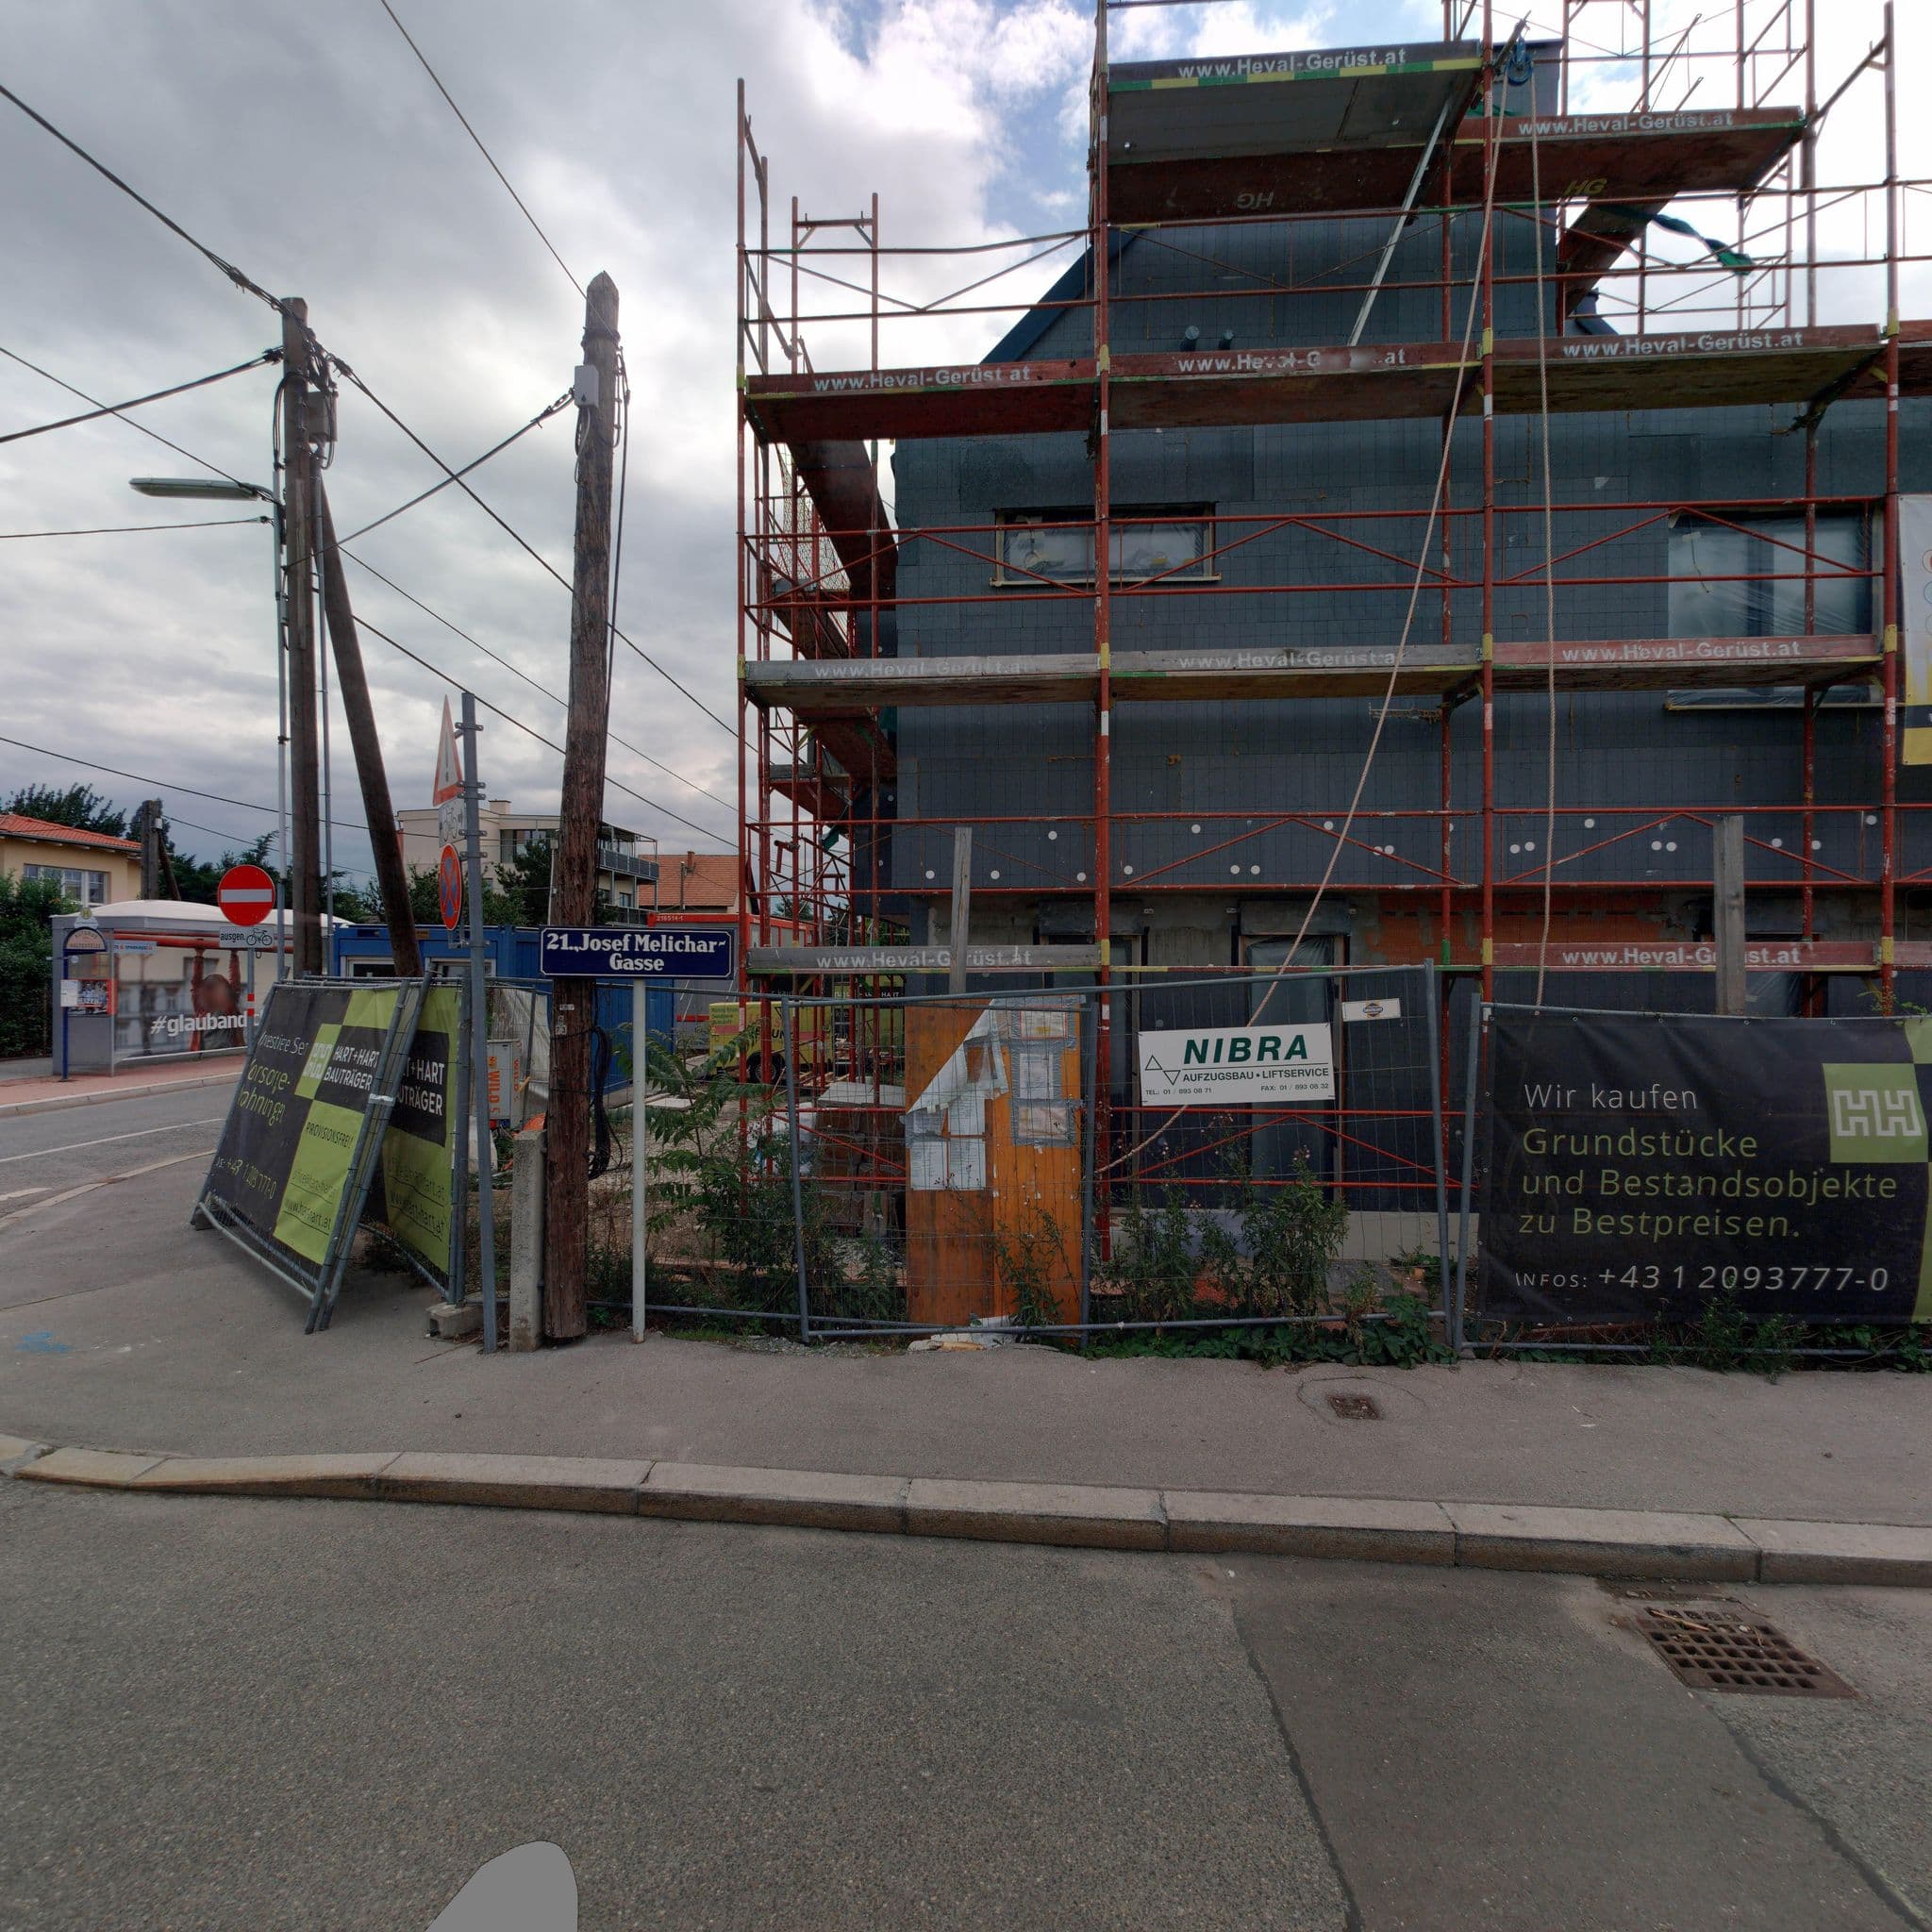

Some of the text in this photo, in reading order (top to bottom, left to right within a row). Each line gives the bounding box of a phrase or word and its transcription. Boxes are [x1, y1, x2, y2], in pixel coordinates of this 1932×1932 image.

[1178, 47, 1406, 78] www.Heval-Gerüst.at
[1518, 110, 1734, 136] www.Heval-Gerüst.at
[1563, 333, 1804, 358] www.Heval-Gerüst.at
[1177, 348, 1406, 372] www.Heval-G.at
[814, 365, 1030, 391] www.Heval-Gerüst.at
[1561, 640, 1801, 662] www.Heval-Gerüst.at
[220, 933, 246, 943] ausgen.
[579, 933, 632, 952] Josef
[609, 954, 665, 972] Gasse
[817, 945, 1032, 968] www.Heval-Grüst.at
[1562, 945, 1802, 965] www.Heval-Gst.at
[1183, 1034, 1308, 1065] NIBRA
[323, 1066, 374, 1091] BAUTRÄGER
[1183, 1067, 1329, 1082] AUFZUGSBAU LIFTSERVICE
[396, 1084, 443, 1116] UTRÄGER
[1524, 1083, 1698, 1110] Wir kaufen
[1523, 1127, 1758, 1158] Grundstücke
[1523, 1169, 1898, 1207] und Bestandsobjekte
[1519, 1208, 1801, 1243] zu Bestpreisen.
[1515, 1271, 1588, 1289] INFOS:
[1599, 1264, 1660, 1290] +43
[1698, 1266, 1889, 1291] 2093777-0
